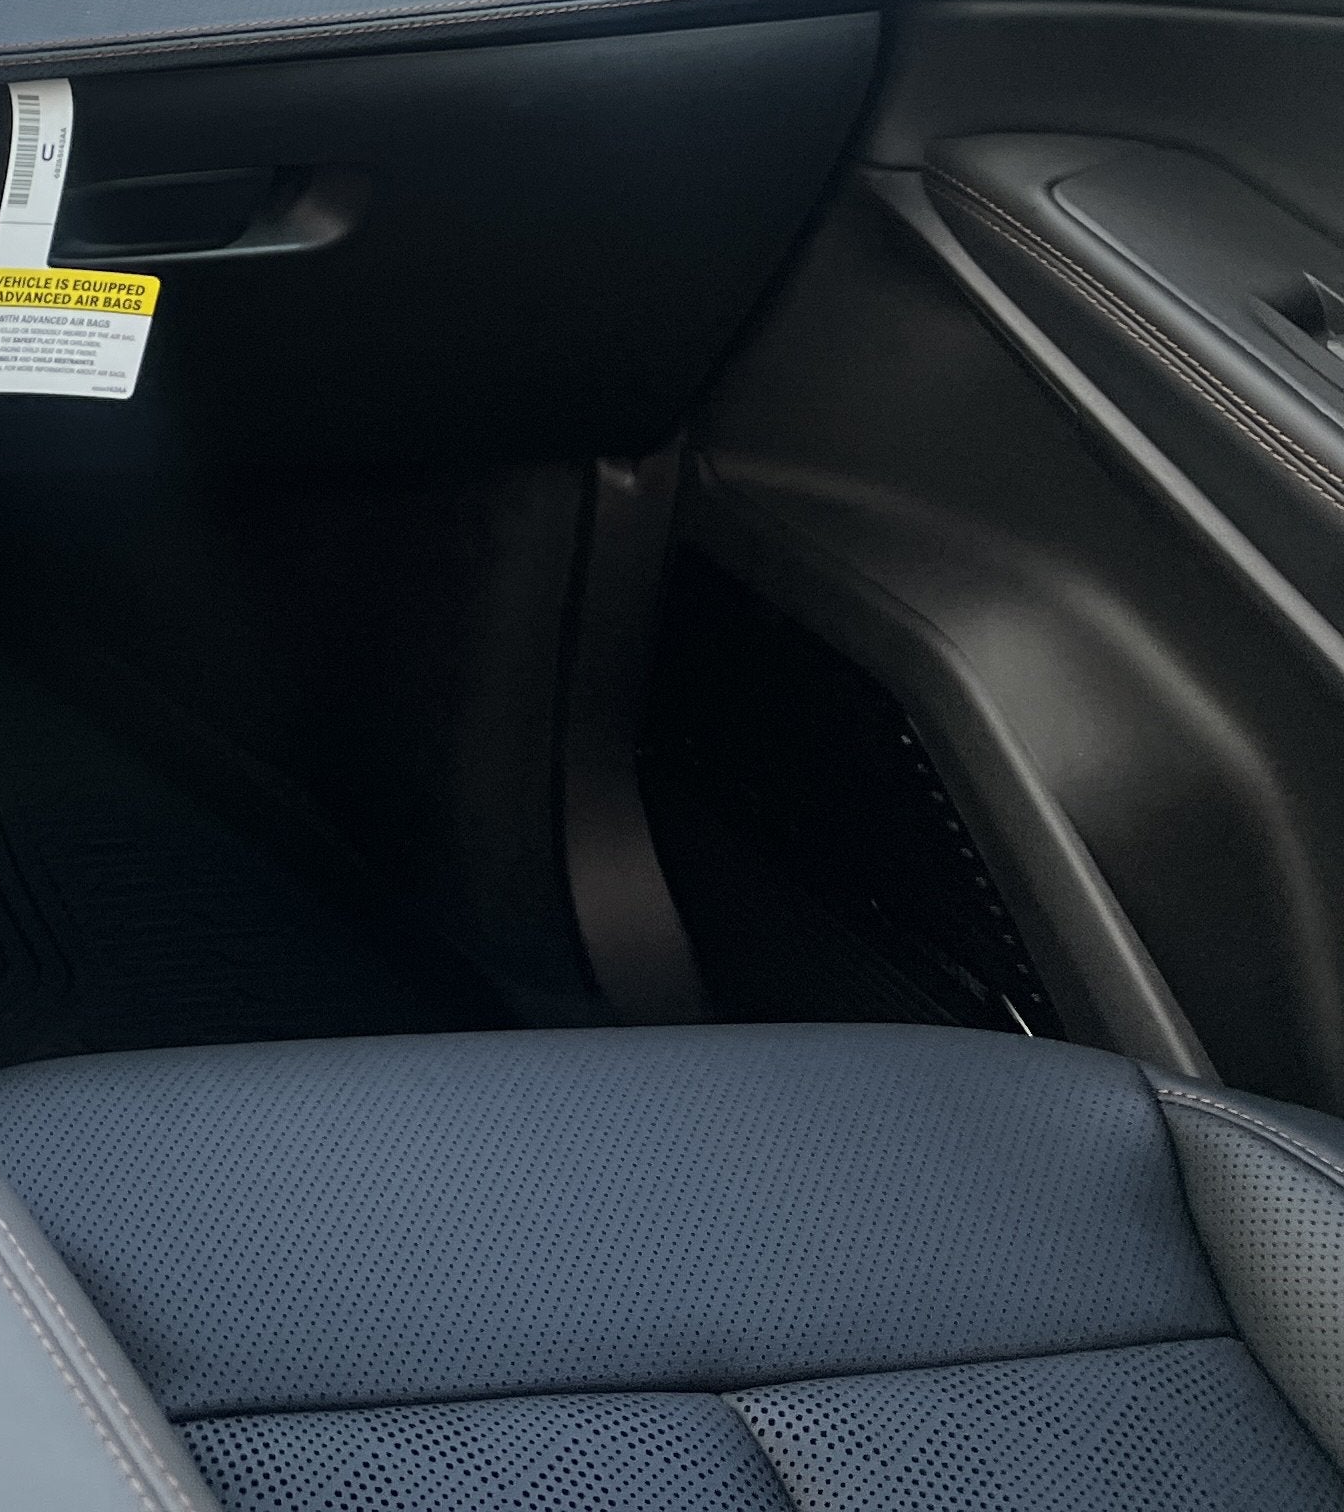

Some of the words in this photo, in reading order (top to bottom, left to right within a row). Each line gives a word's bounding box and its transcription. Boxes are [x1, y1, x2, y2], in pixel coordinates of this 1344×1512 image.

[54, 278, 69, 289] IS
[72, 279, 145, 296] EQUIPPED
[74, 294, 99, 307] AIR
[102, 296, 142, 311] BAGS
[21, 315, 68, 326] ADVANCED
[69, 317, 84, 326] AIR
[85, 318, 111, 329] BAGS
